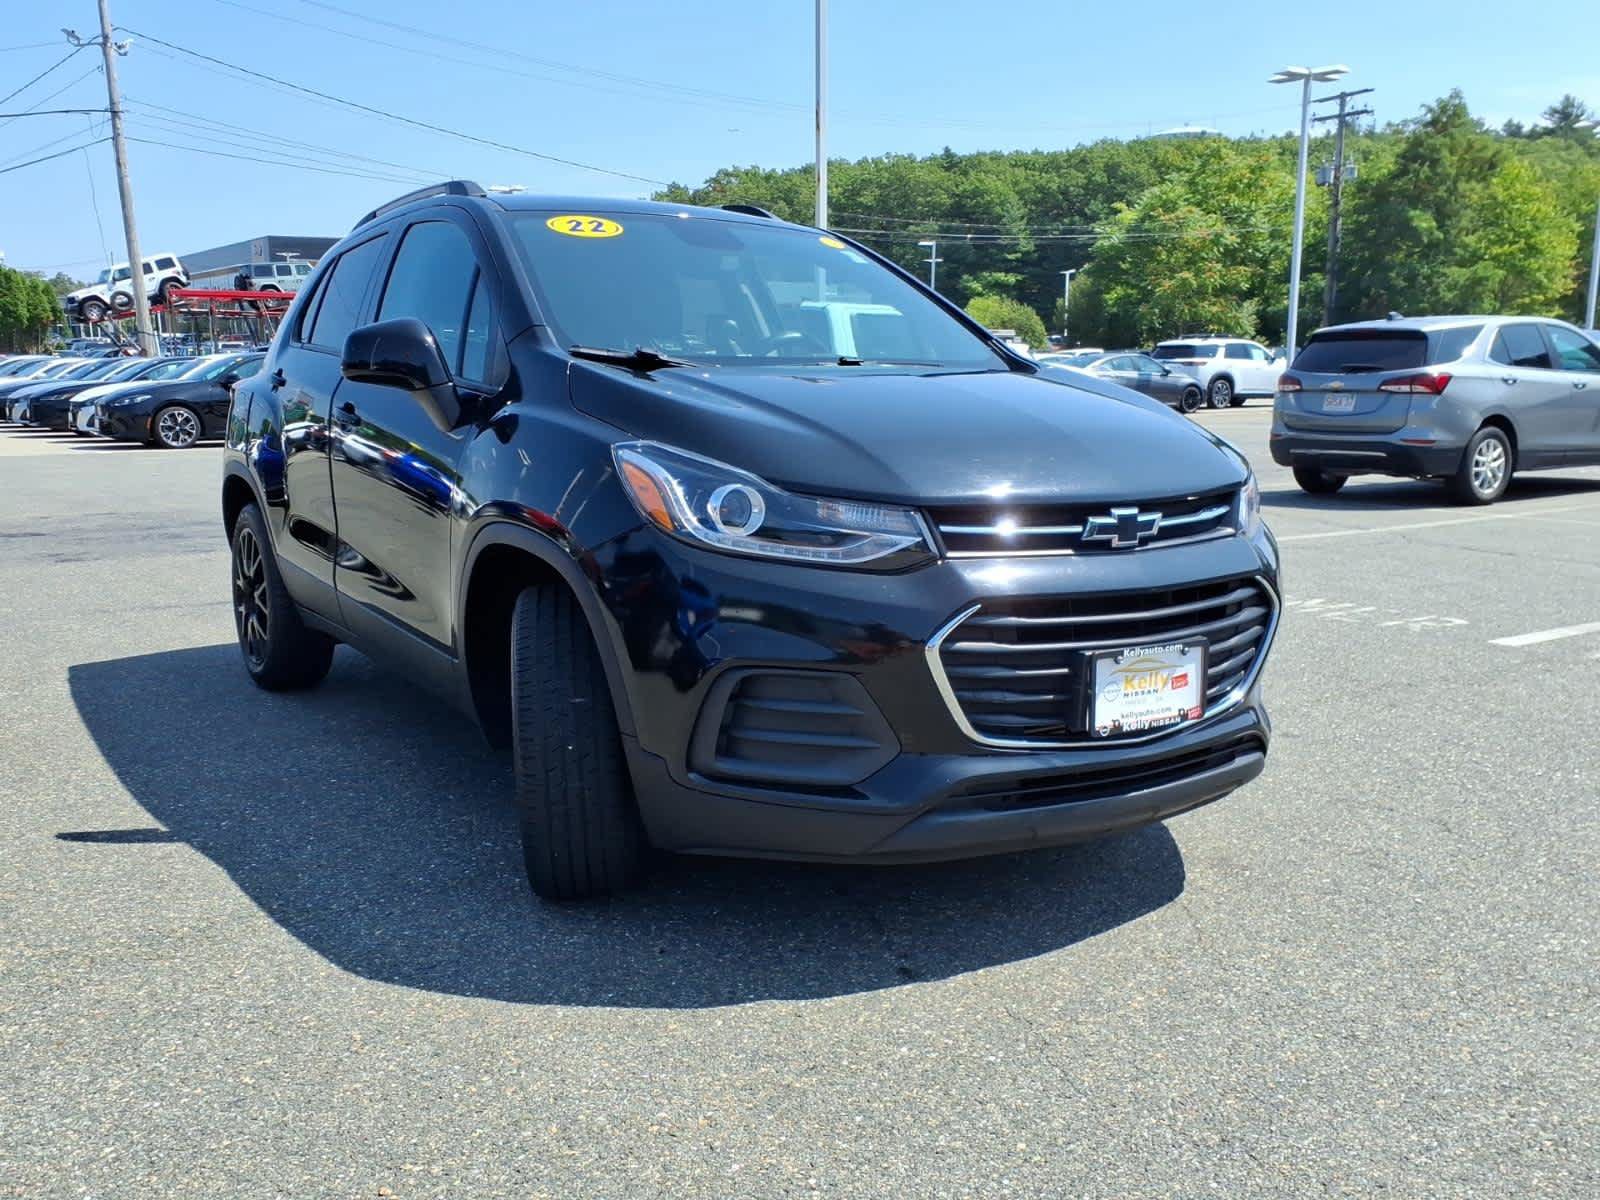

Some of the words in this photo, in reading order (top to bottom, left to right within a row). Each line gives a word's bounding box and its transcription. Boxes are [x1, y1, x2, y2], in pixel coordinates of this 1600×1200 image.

[566, 219, 607, 233] 22
[1123, 644, 1183, 657] Kellyauto.com
[1123, 671, 1169, 691] Kelly
[1123, 688, 1159, 697] NISSAN
[1121, 706, 1172, 719] kellyauto.com
[1122, 719, 1151, 732] Kelly
[1151, 716, 1181, 728] NISSAN
